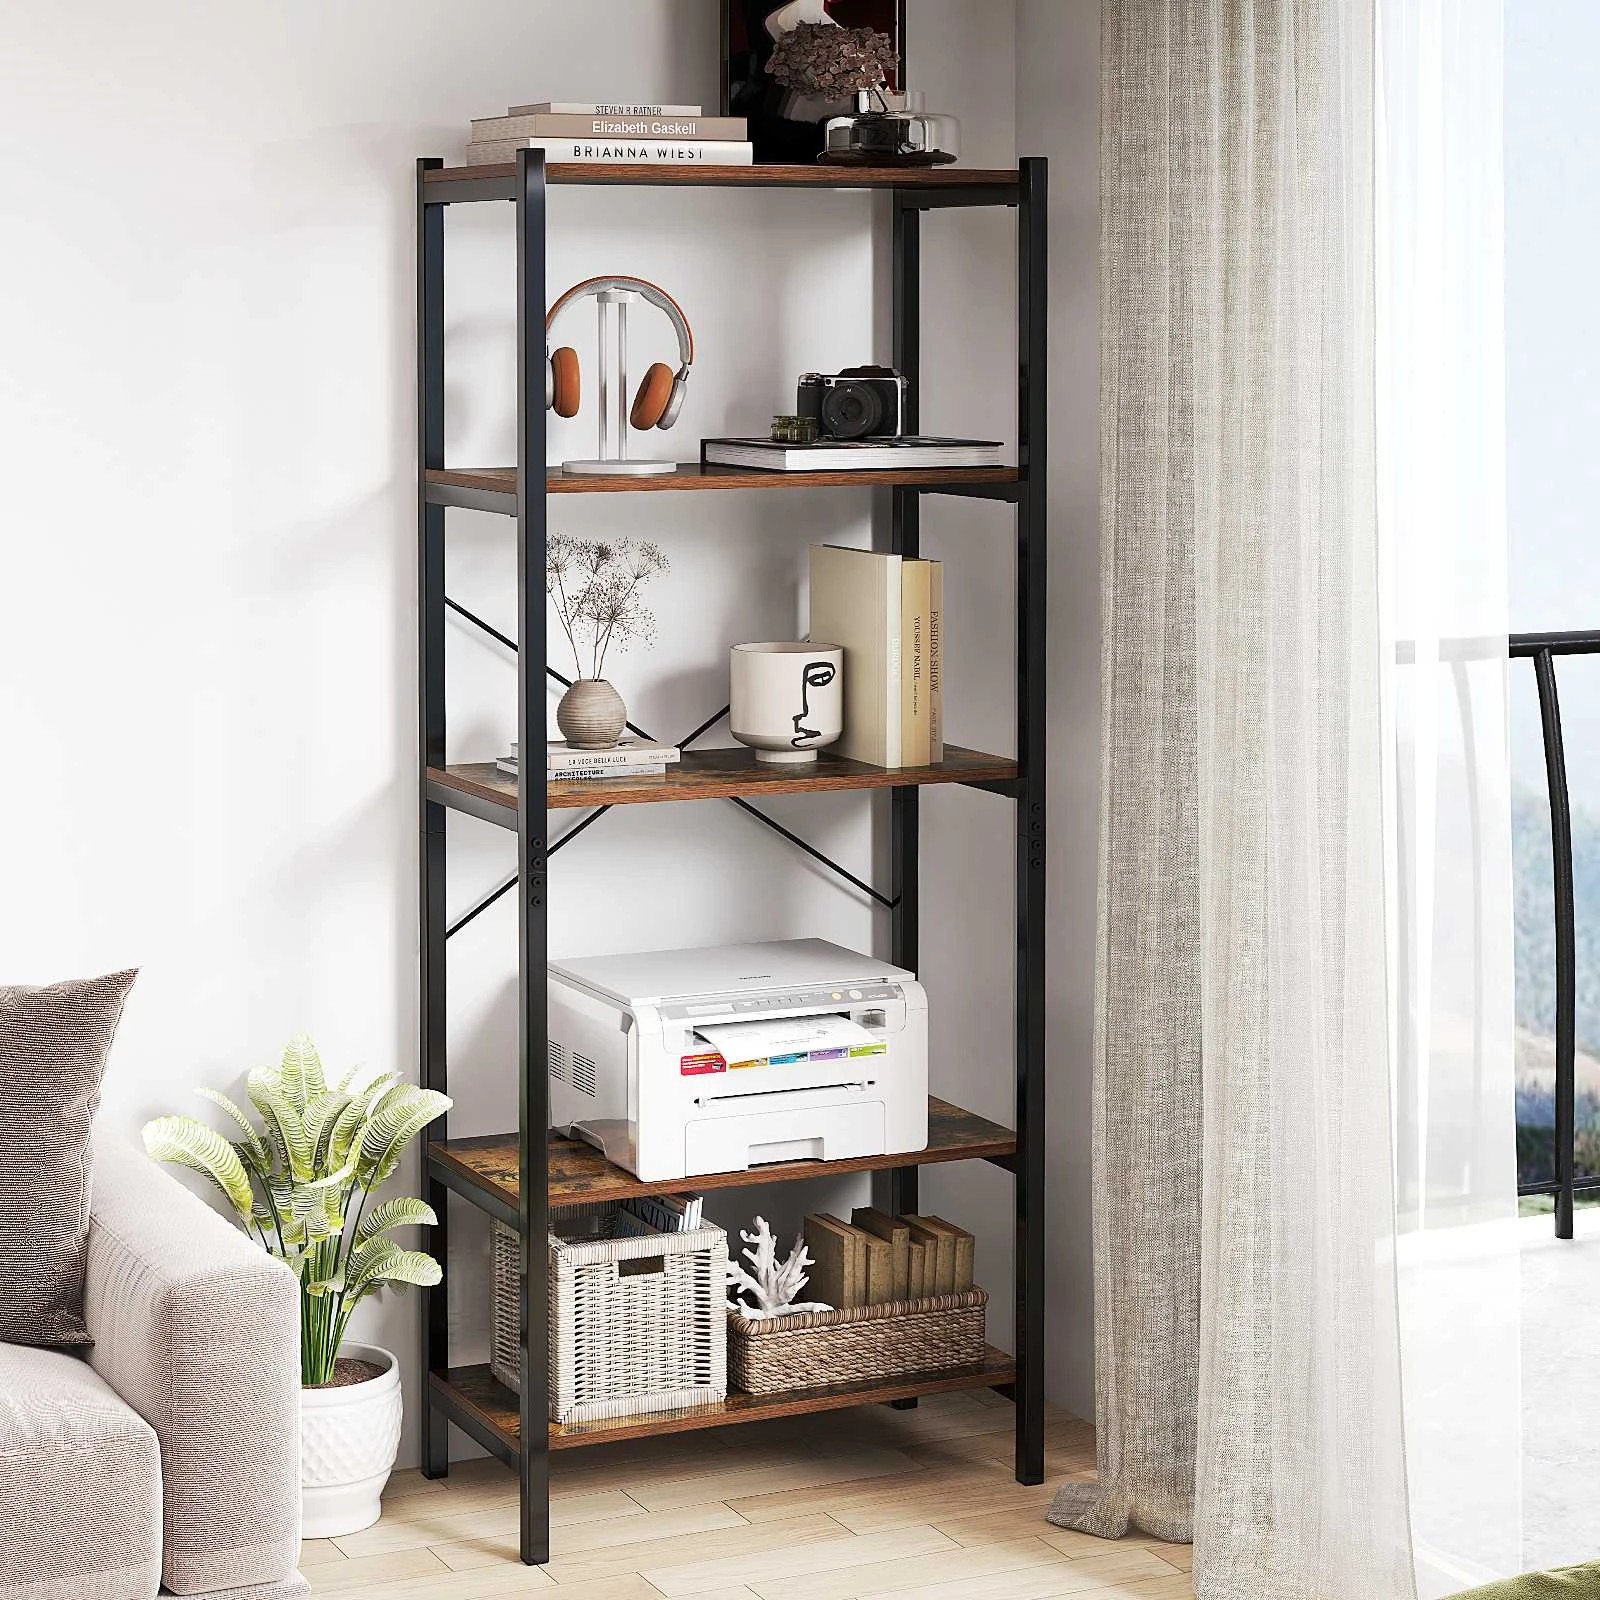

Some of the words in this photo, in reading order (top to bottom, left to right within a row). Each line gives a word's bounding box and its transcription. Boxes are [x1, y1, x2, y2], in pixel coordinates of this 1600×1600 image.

[595, 105, 624, 115] STEVEN
[633, 106, 662, 116] RATNER
[592, 120, 648, 134] Elizabeth
[651, 121, 697, 136] Gaskell
[573, 145, 649, 159] BRIANNA
[656, 146, 703, 160] WIEST
[930, 610, 939, 658] FASHION
[913, 655, 921, 681] NABIL
[930, 660, 939, 693] SHOW
[554, 769, 604, 778] ARCHITECTURE
